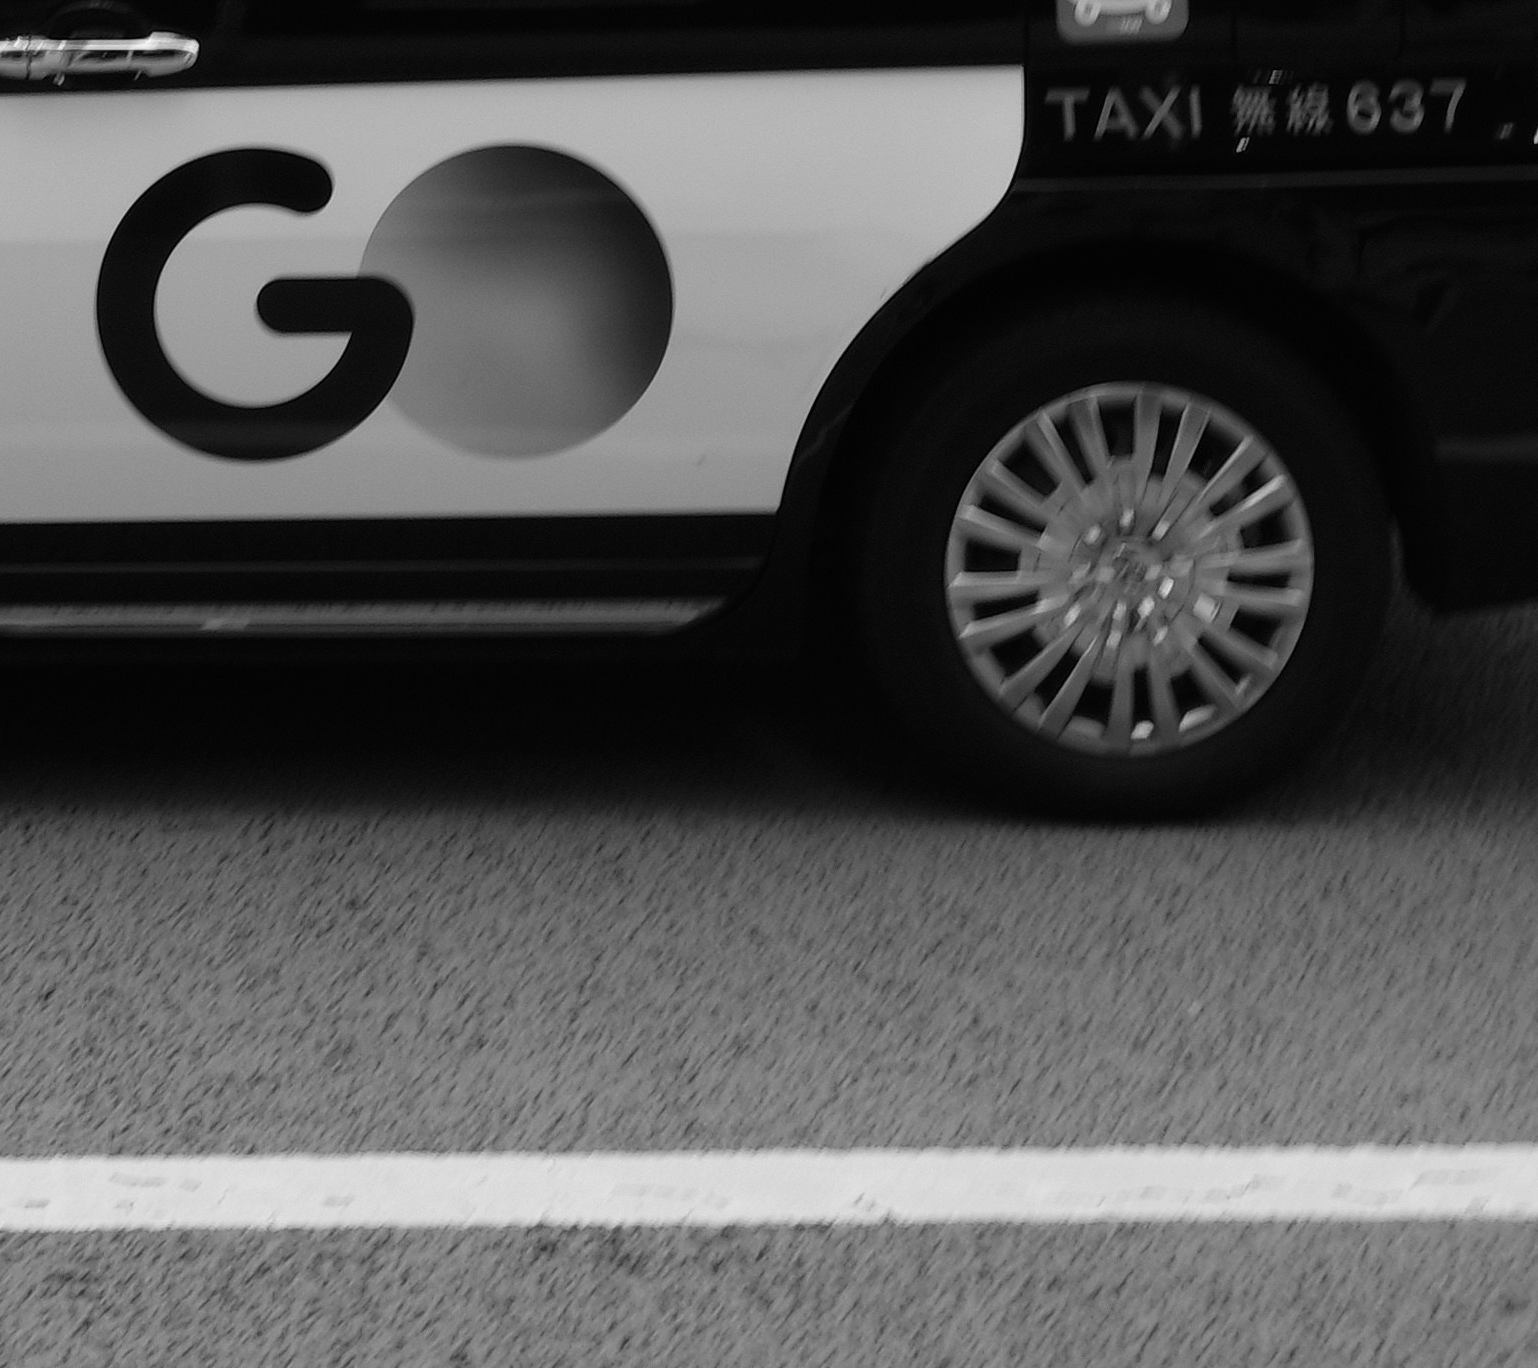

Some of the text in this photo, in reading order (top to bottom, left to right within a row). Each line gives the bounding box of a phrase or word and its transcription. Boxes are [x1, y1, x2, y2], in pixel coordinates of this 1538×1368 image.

[1044, 84, 1203, 144] TAXI
[1346, 77, 1468, 135] 637
[95, 142, 675, 462] GO
